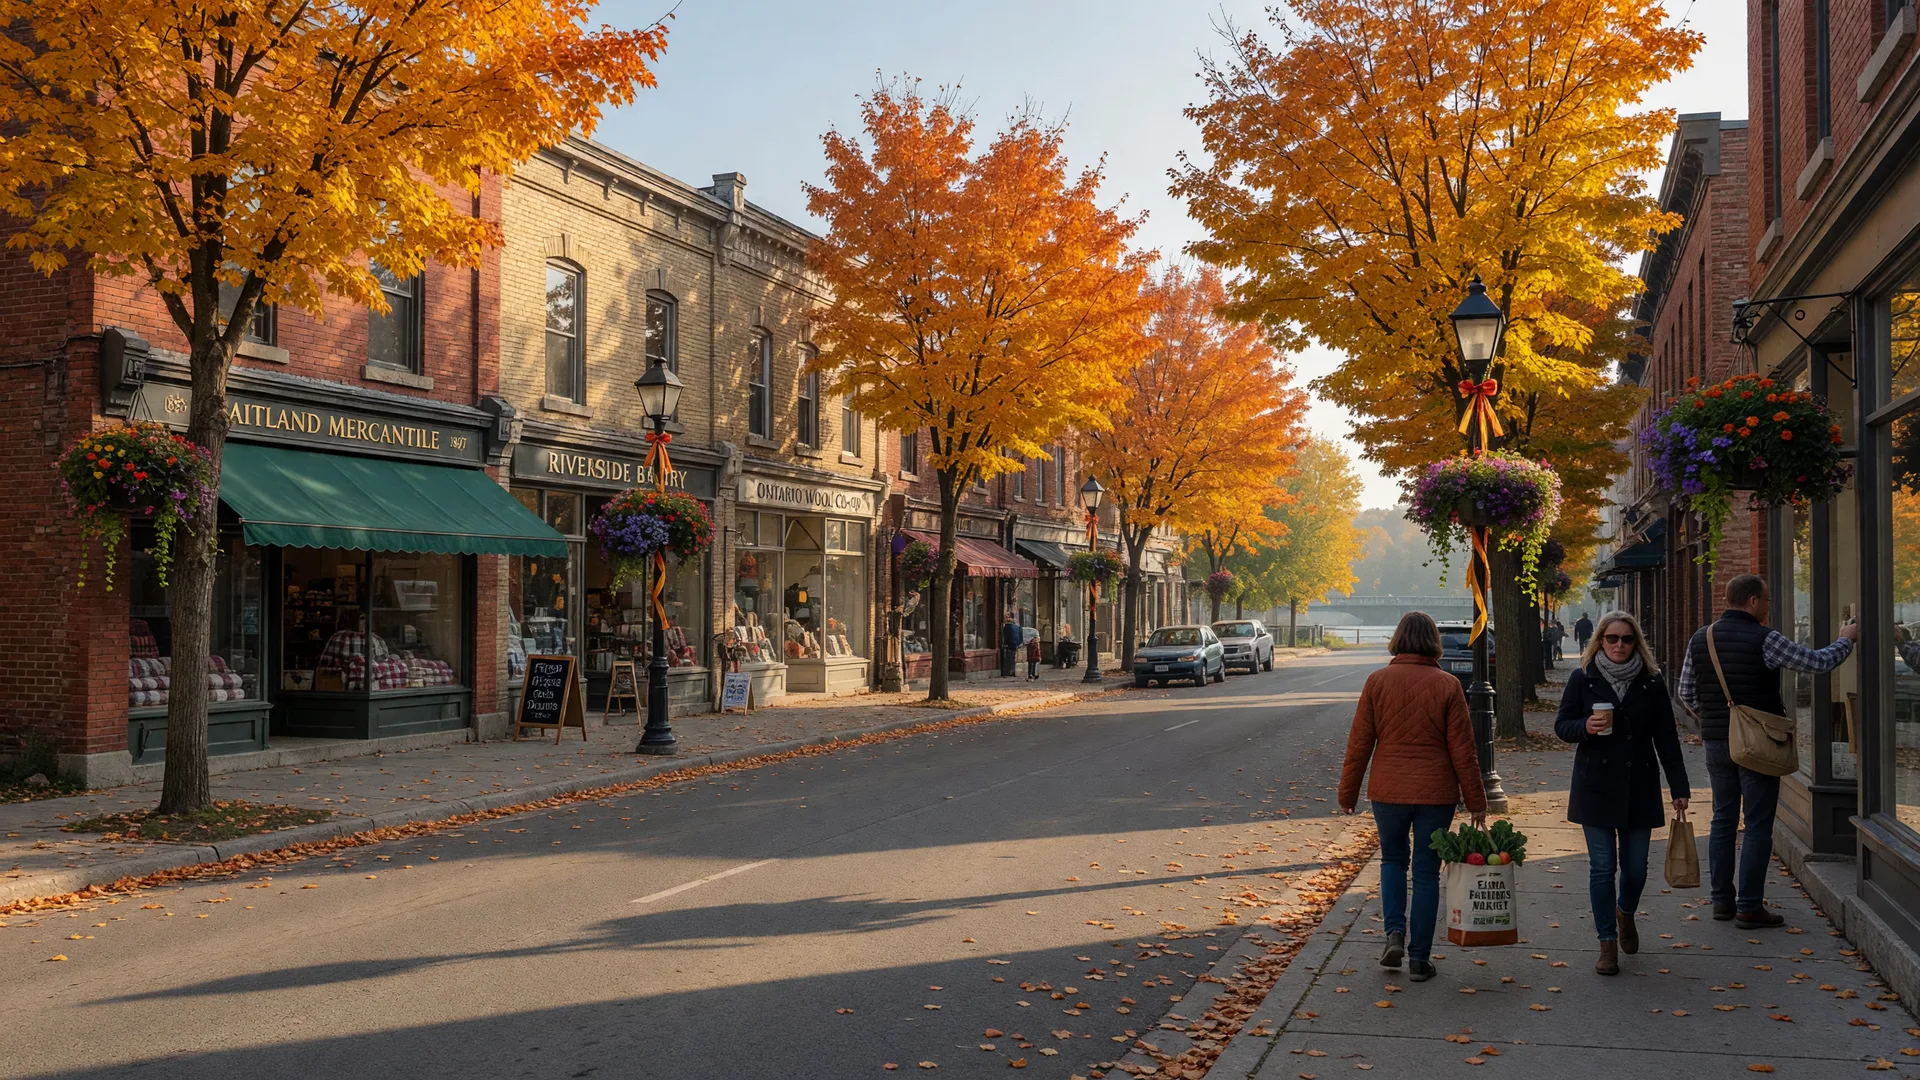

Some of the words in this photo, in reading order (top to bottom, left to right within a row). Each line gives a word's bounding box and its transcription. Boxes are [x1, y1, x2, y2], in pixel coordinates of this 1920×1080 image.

[229, 402, 321, 434] AITLAND
[328, 415, 440, 450] MERCANTILE
[548, 451, 631, 483] RIVERSIDE
[636, 465, 687, 489] BARY
[757, 482, 802, 504] ONTARIO
[805, 487, 834, 508] WOOL
